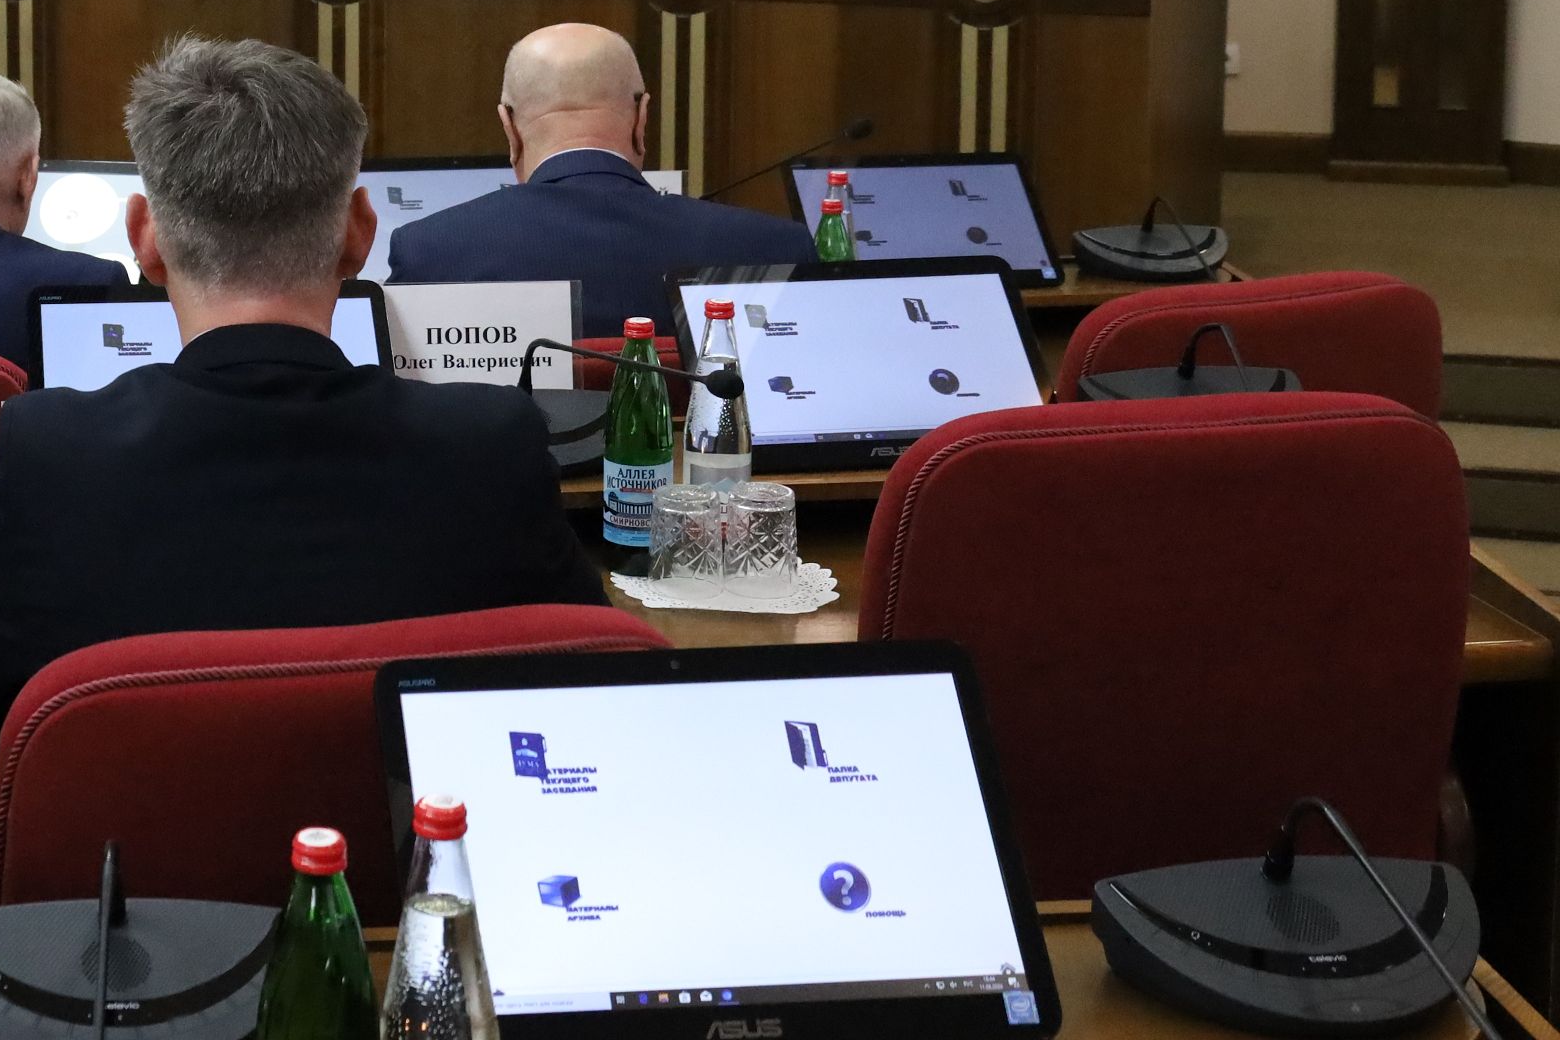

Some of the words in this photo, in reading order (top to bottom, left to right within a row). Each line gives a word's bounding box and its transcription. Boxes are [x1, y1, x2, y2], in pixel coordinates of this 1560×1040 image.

[426, 326, 517, 345] ПОПОВ
[394, 355, 437, 370] Олег
[618, 468, 655, 479] АЛЛЕЯ
[610, 515, 651, 527] СМИРНОВС
[545, 767, 597, 775] АТЕРИАЛЫ
[828, 765, 859, 773] ПАПКА
[706, 1018, 783, 1040] ASUS
